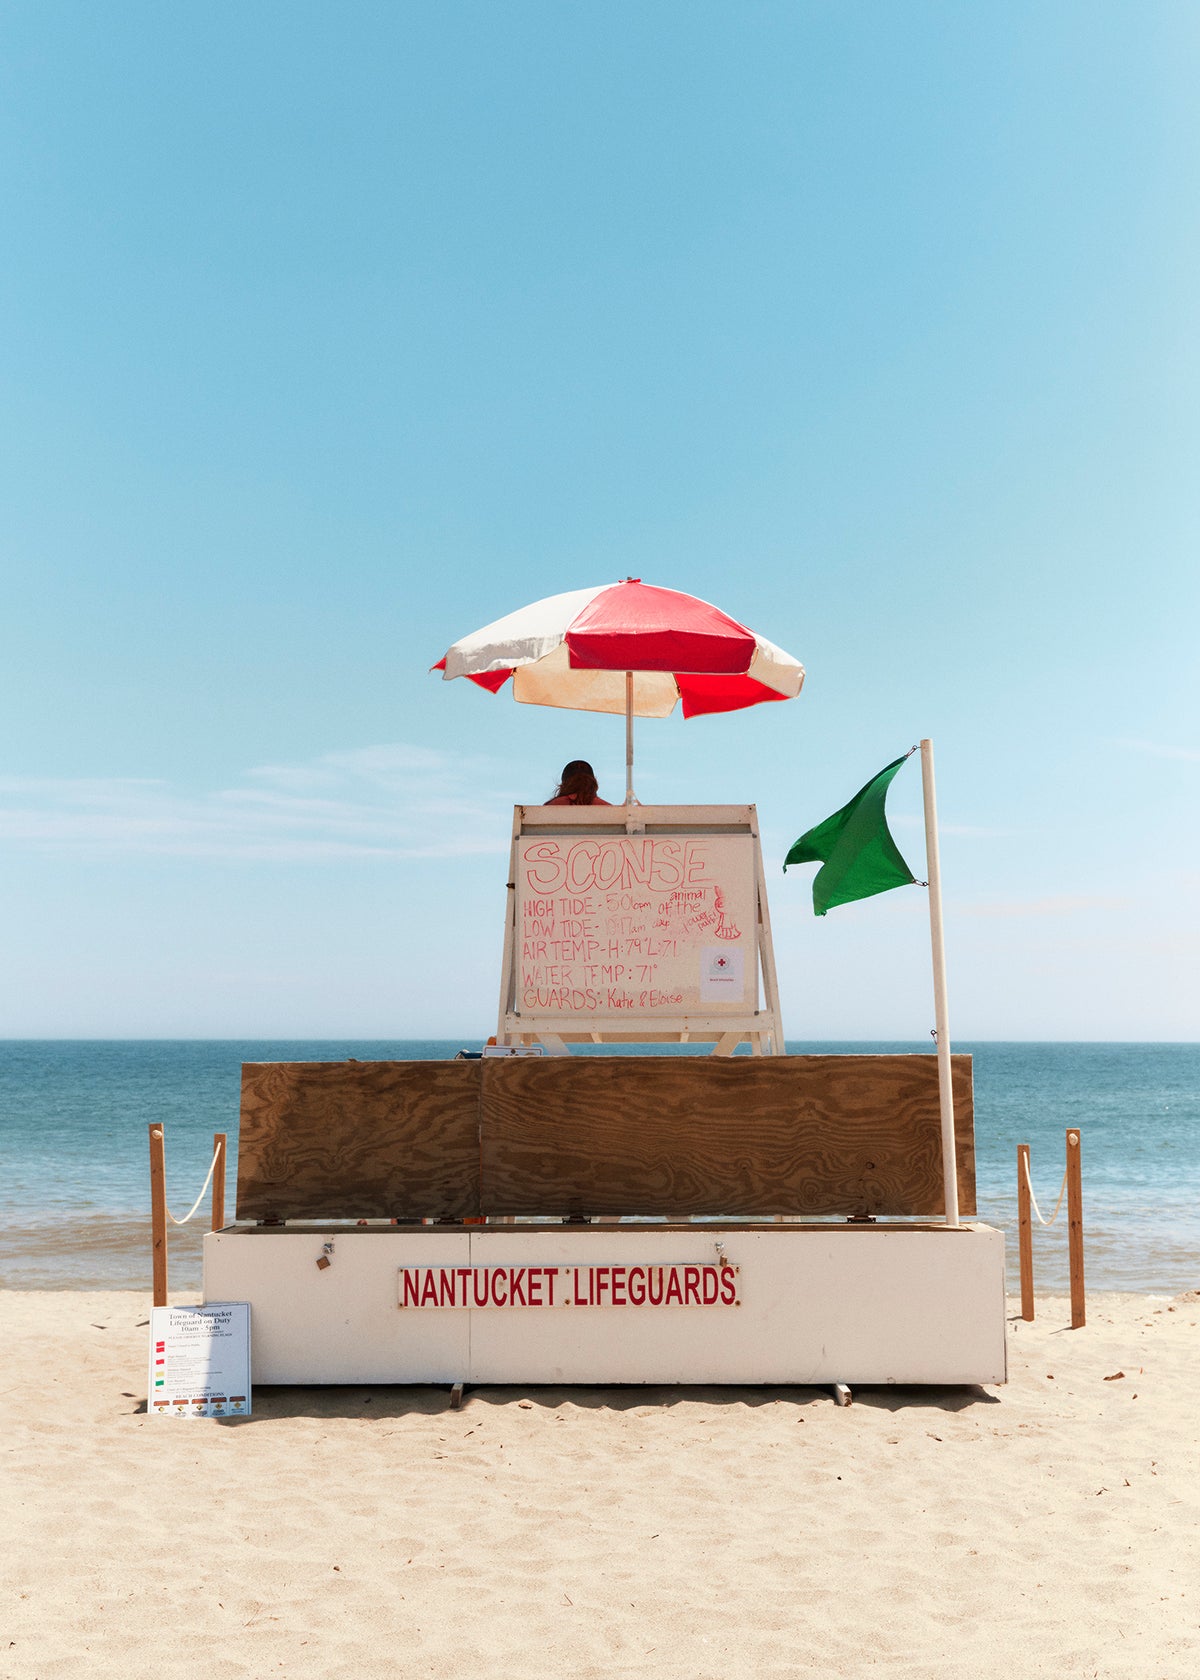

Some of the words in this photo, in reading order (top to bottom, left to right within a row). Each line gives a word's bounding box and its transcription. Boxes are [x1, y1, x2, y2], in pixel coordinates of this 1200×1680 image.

[670, 889, 706, 901] animal
[523, 899, 554, 917] HIGH
[657, 901, 673, 915] of
[677, 902, 701, 915] the
[523, 919, 555, 938] LOW
[523, 940, 552, 961] AIR
[522, 965, 574, 988] WATER
[607, 987, 634, 1009] Katie
[649, 989, 683, 1008] Eloise
[403, 1268, 558, 1307] NANTUCKET
[574, 1266, 736, 1306] LIFEGUARDS
[169, 1319, 202, 1327] Lifeguard
[214, 1317, 231, 1325] Duty
